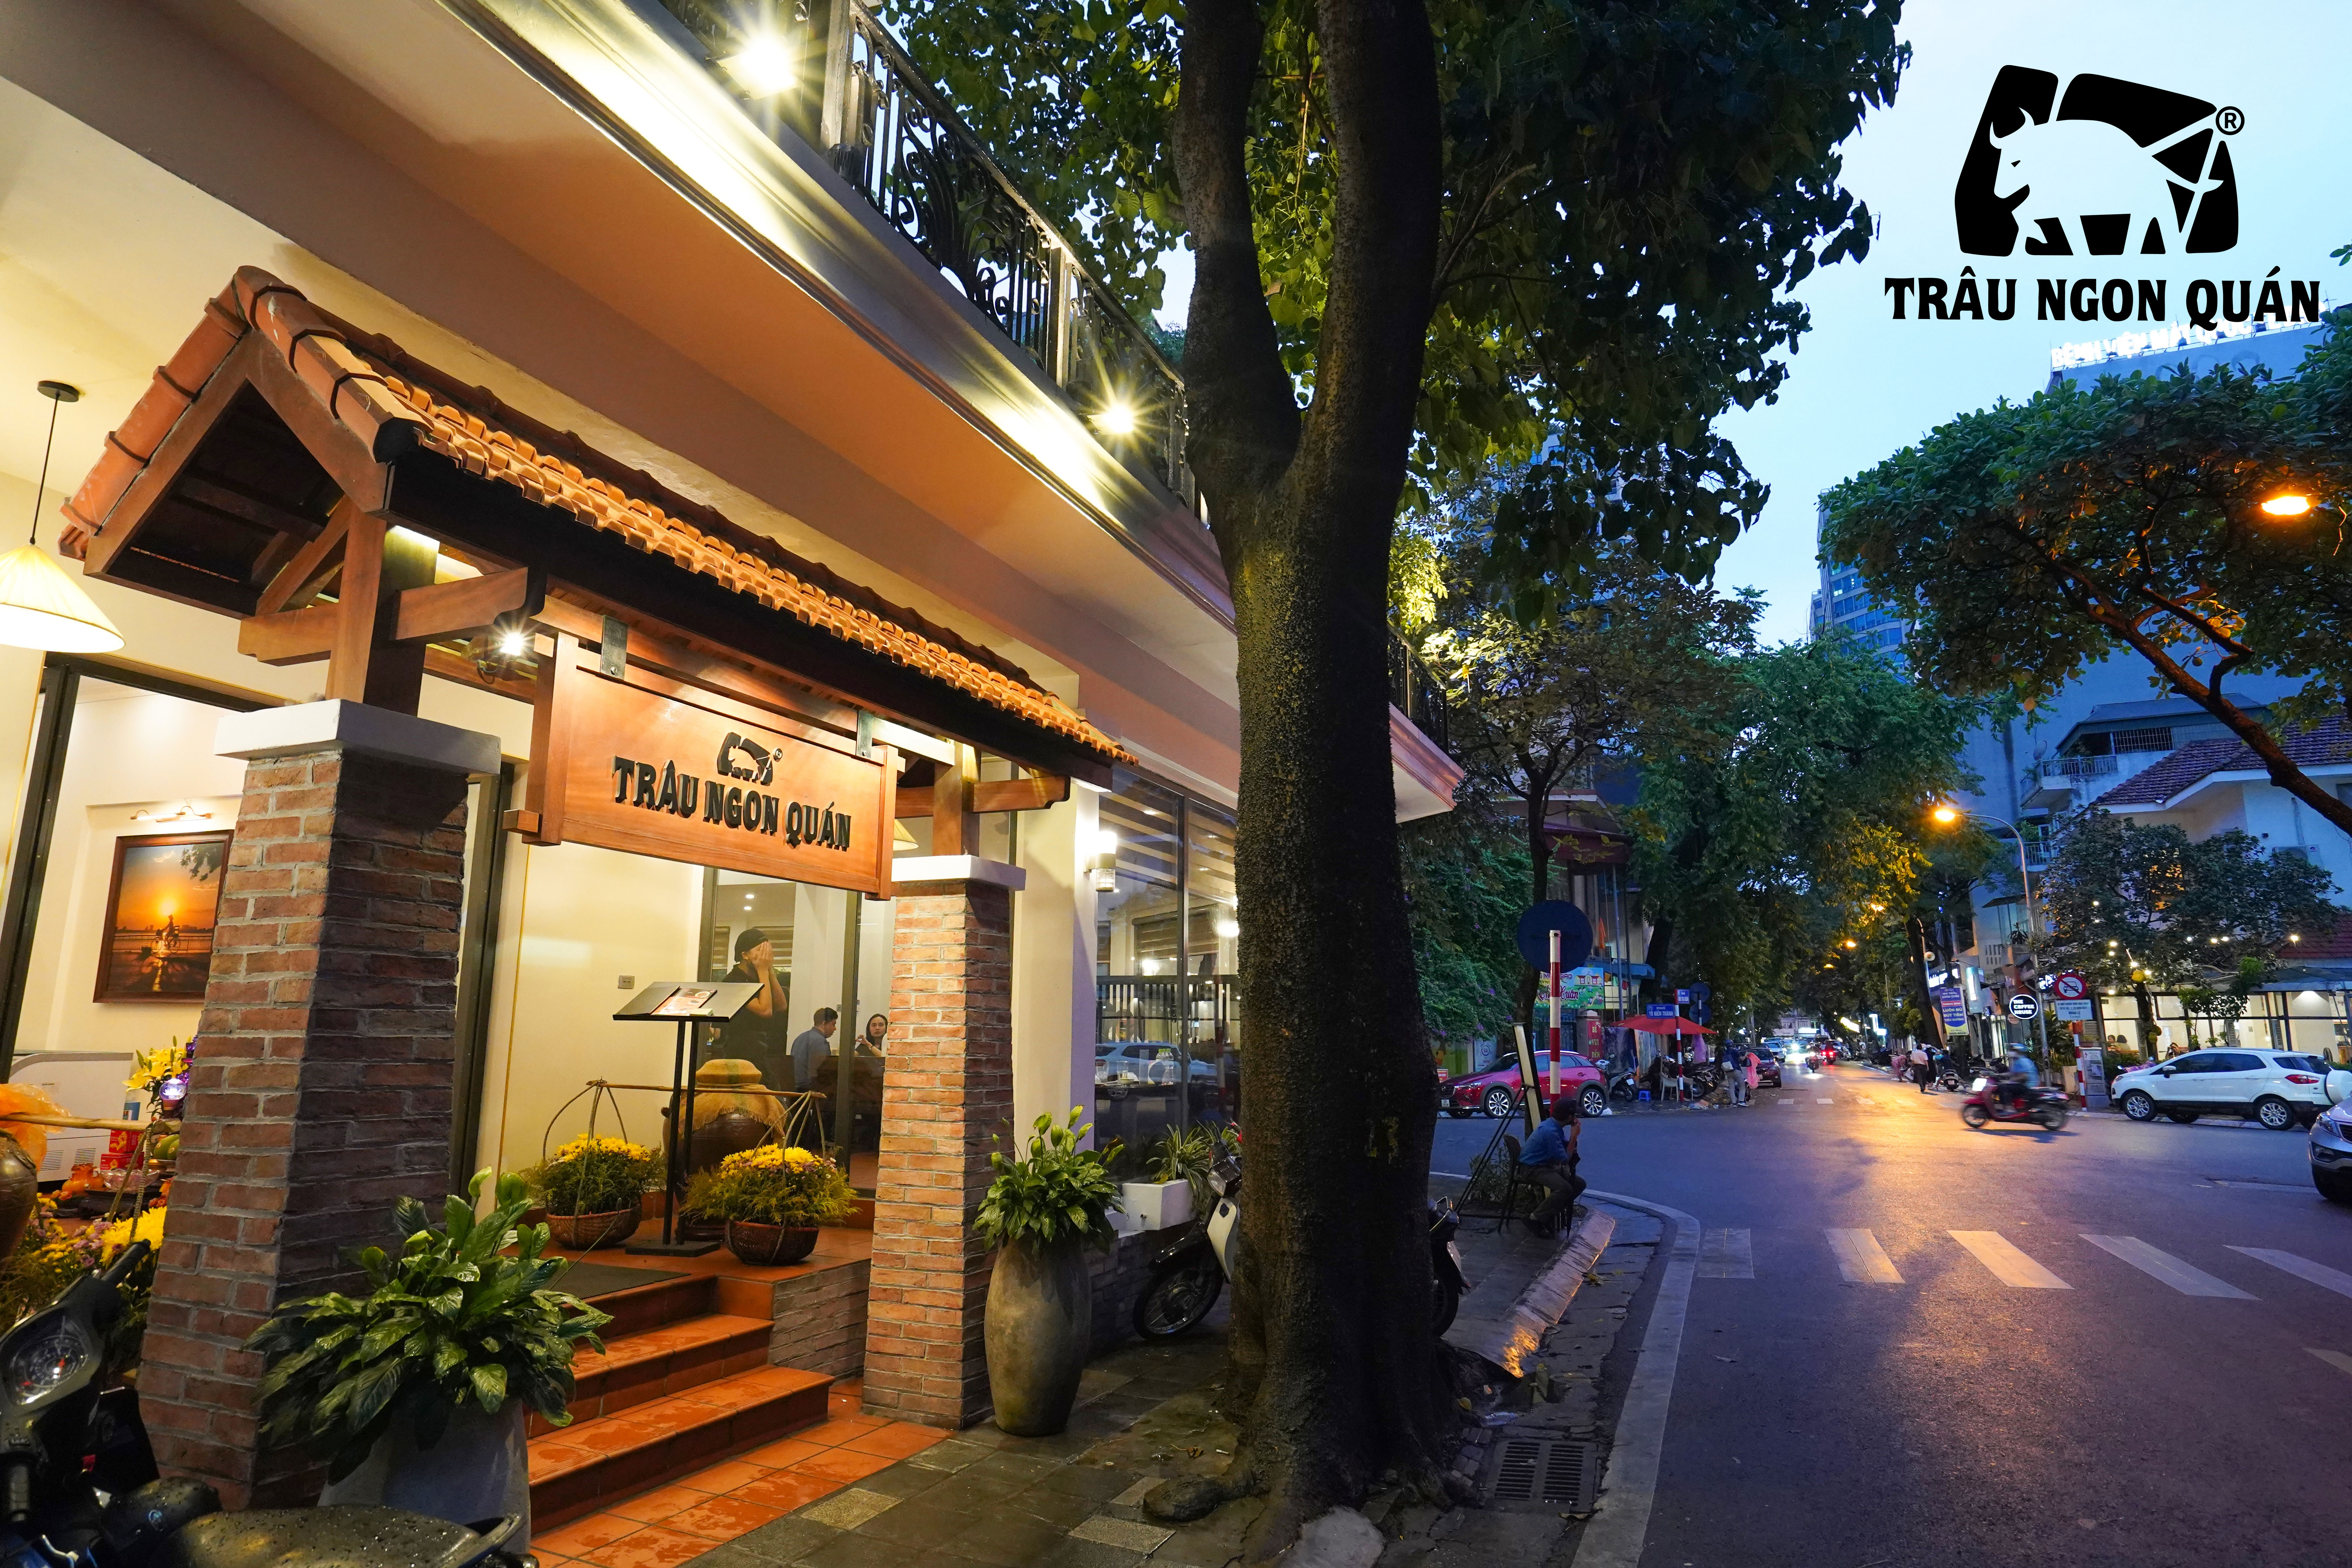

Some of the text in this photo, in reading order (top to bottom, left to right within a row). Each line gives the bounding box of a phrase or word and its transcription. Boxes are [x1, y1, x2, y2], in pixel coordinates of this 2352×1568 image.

[612, 755, 851, 851] TRÂU NGON QUÁN
